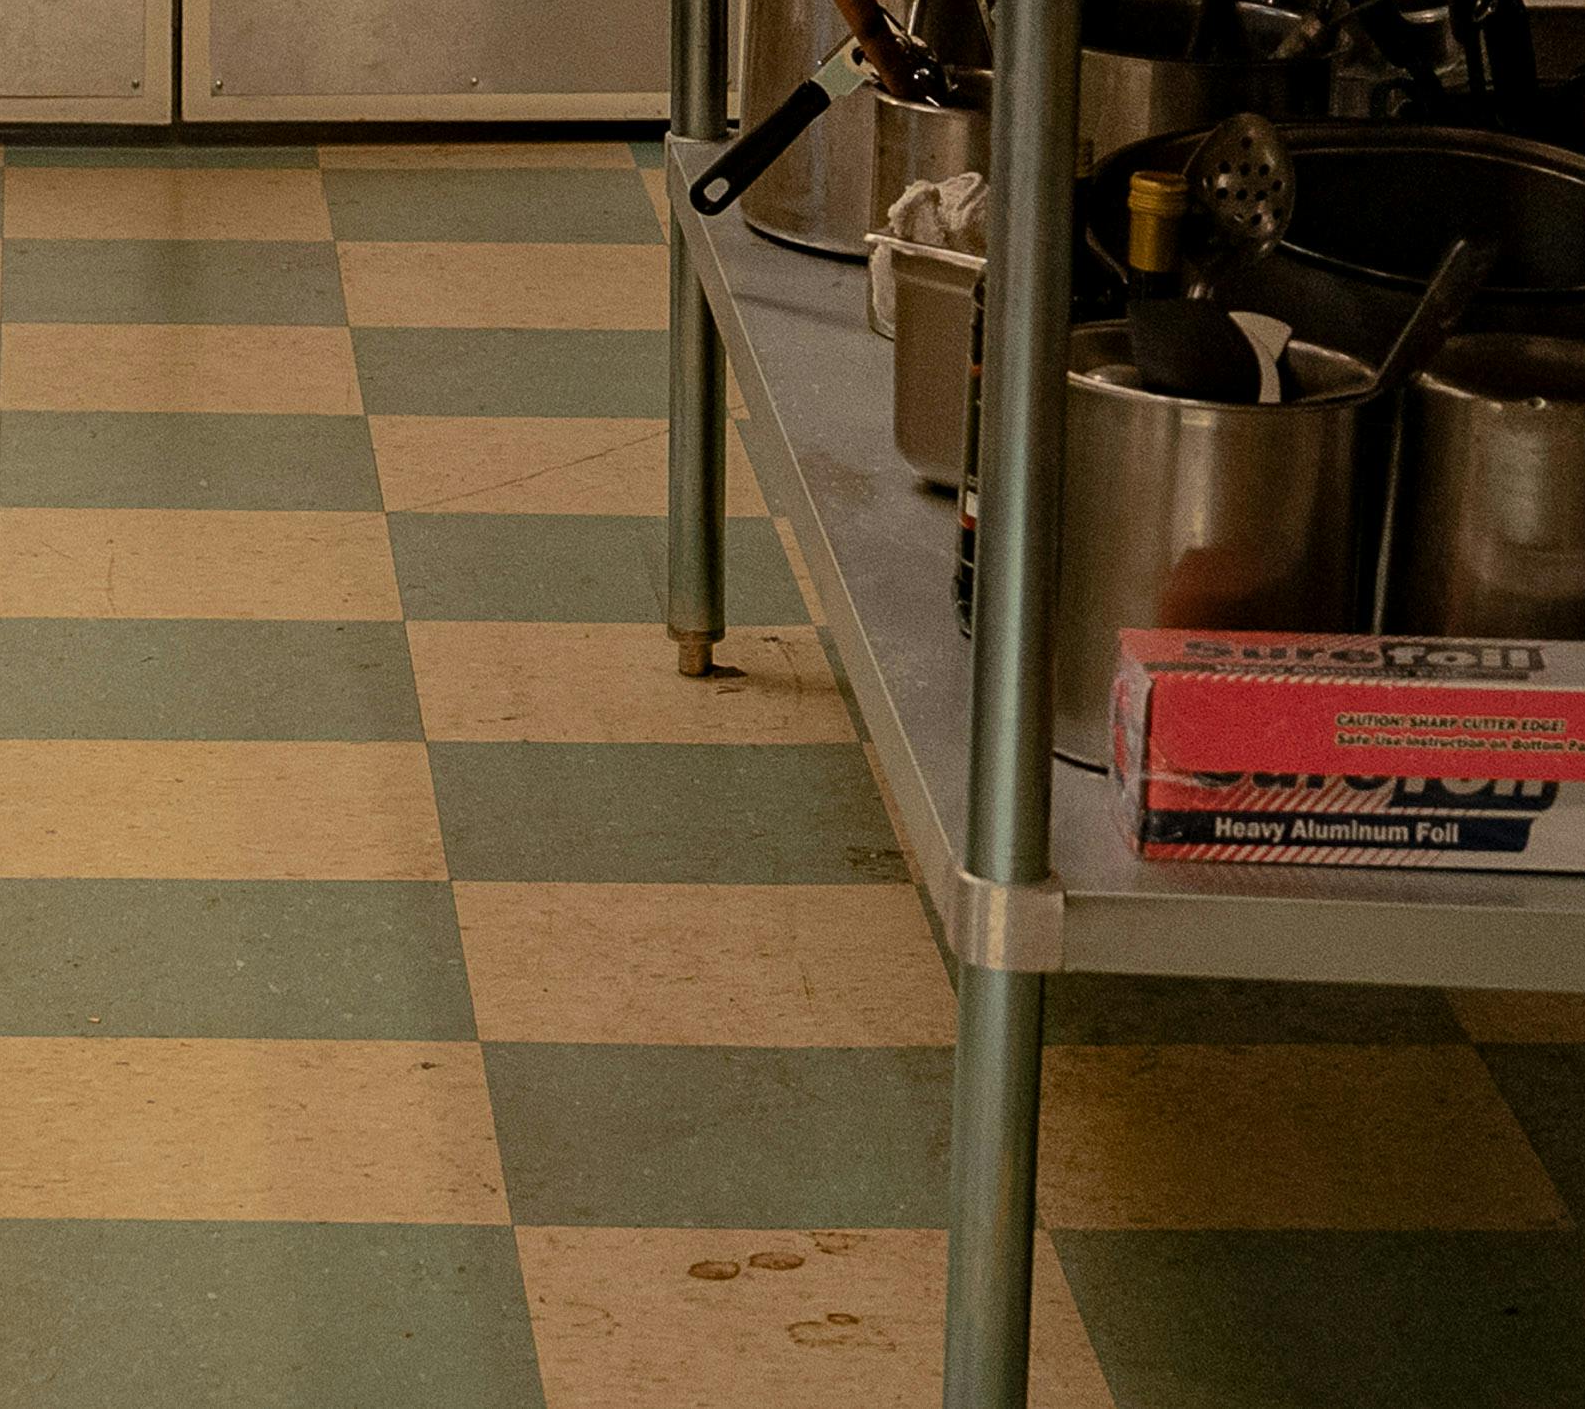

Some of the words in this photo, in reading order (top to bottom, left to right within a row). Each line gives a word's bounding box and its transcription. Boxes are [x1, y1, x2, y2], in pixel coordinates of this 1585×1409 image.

[1336, 713, 1404, 728] CAUTION!
[1409, 714, 1458, 730] SHARP
[1462, 716, 1517, 731] CUTTER
[1521, 718, 1566, 733] EDGE!
[1336, 732, 1372, 746] Safe
[1375, 734, 1401, 747] Use
[1489, 738, 1508, 750] on
[1512, 737, 1564, 752] Bottom
[1215, 817, 1286, 844] Heavy
[1291, 819, 1409, 843] Aluminum
[1415, 822, 1460, 844] Foil
